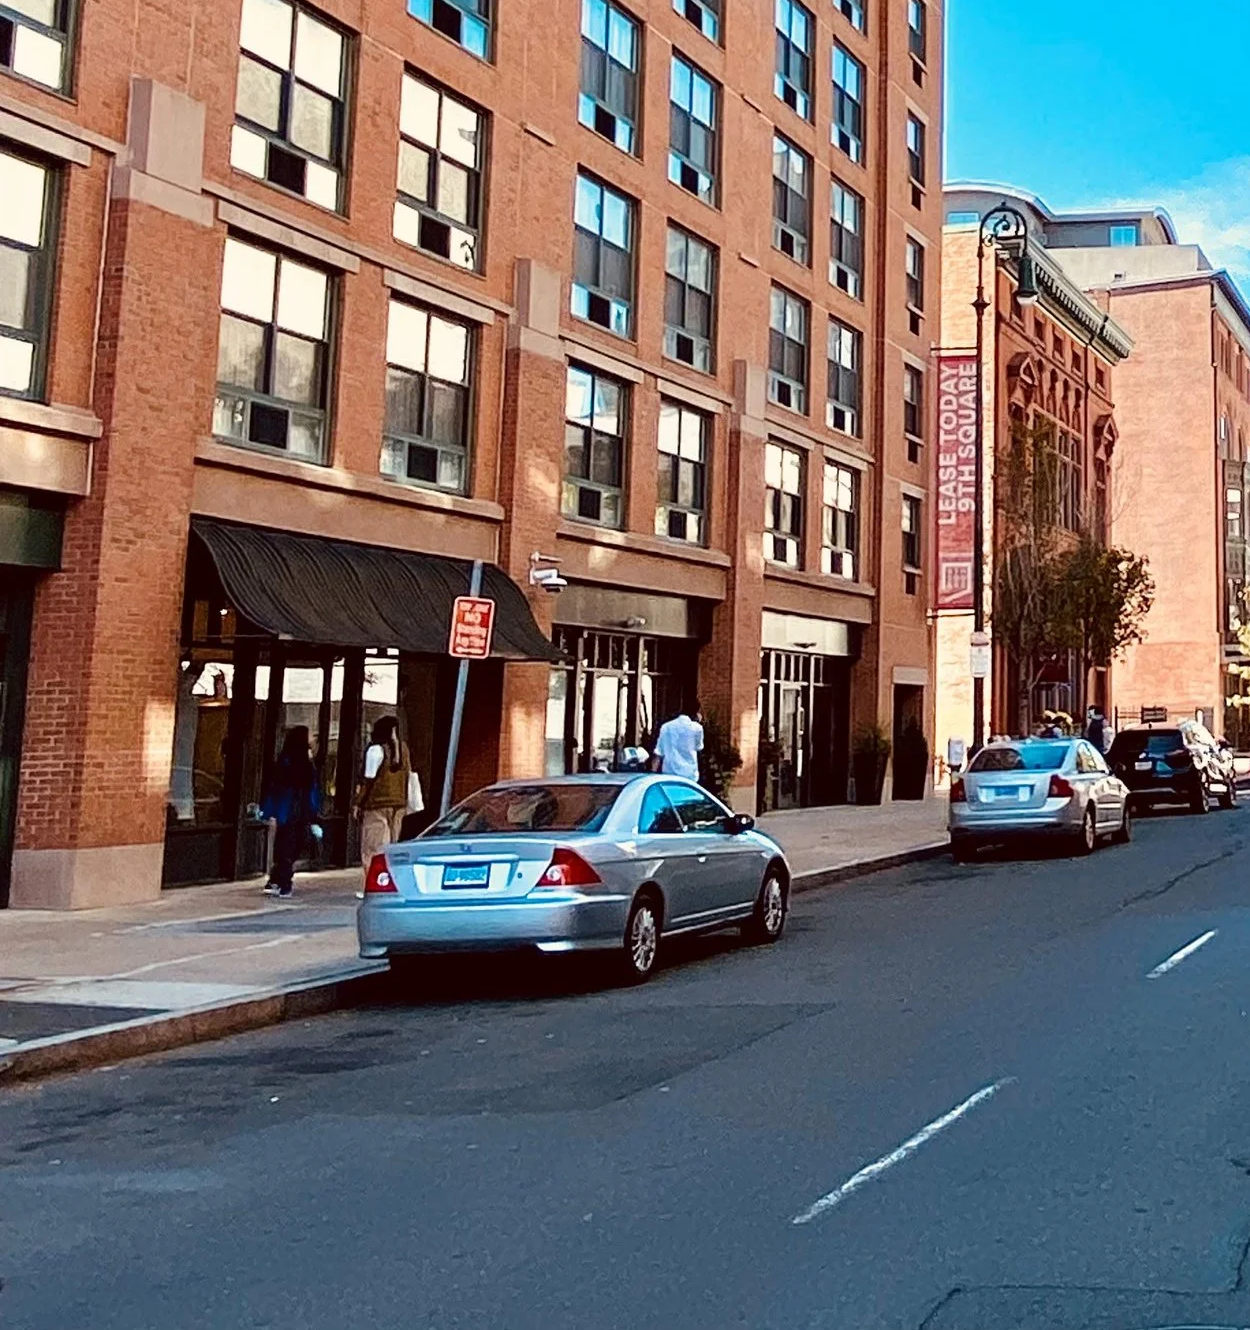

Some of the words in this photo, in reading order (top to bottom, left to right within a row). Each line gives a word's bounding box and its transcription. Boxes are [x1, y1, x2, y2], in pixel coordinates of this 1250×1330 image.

[939, 364, 958, 444] TODAY
[957, 363, 977, 459] SQUARE
[939, 452, 957, 525] LEASE
[957, 465, 976, 512] 9TH
